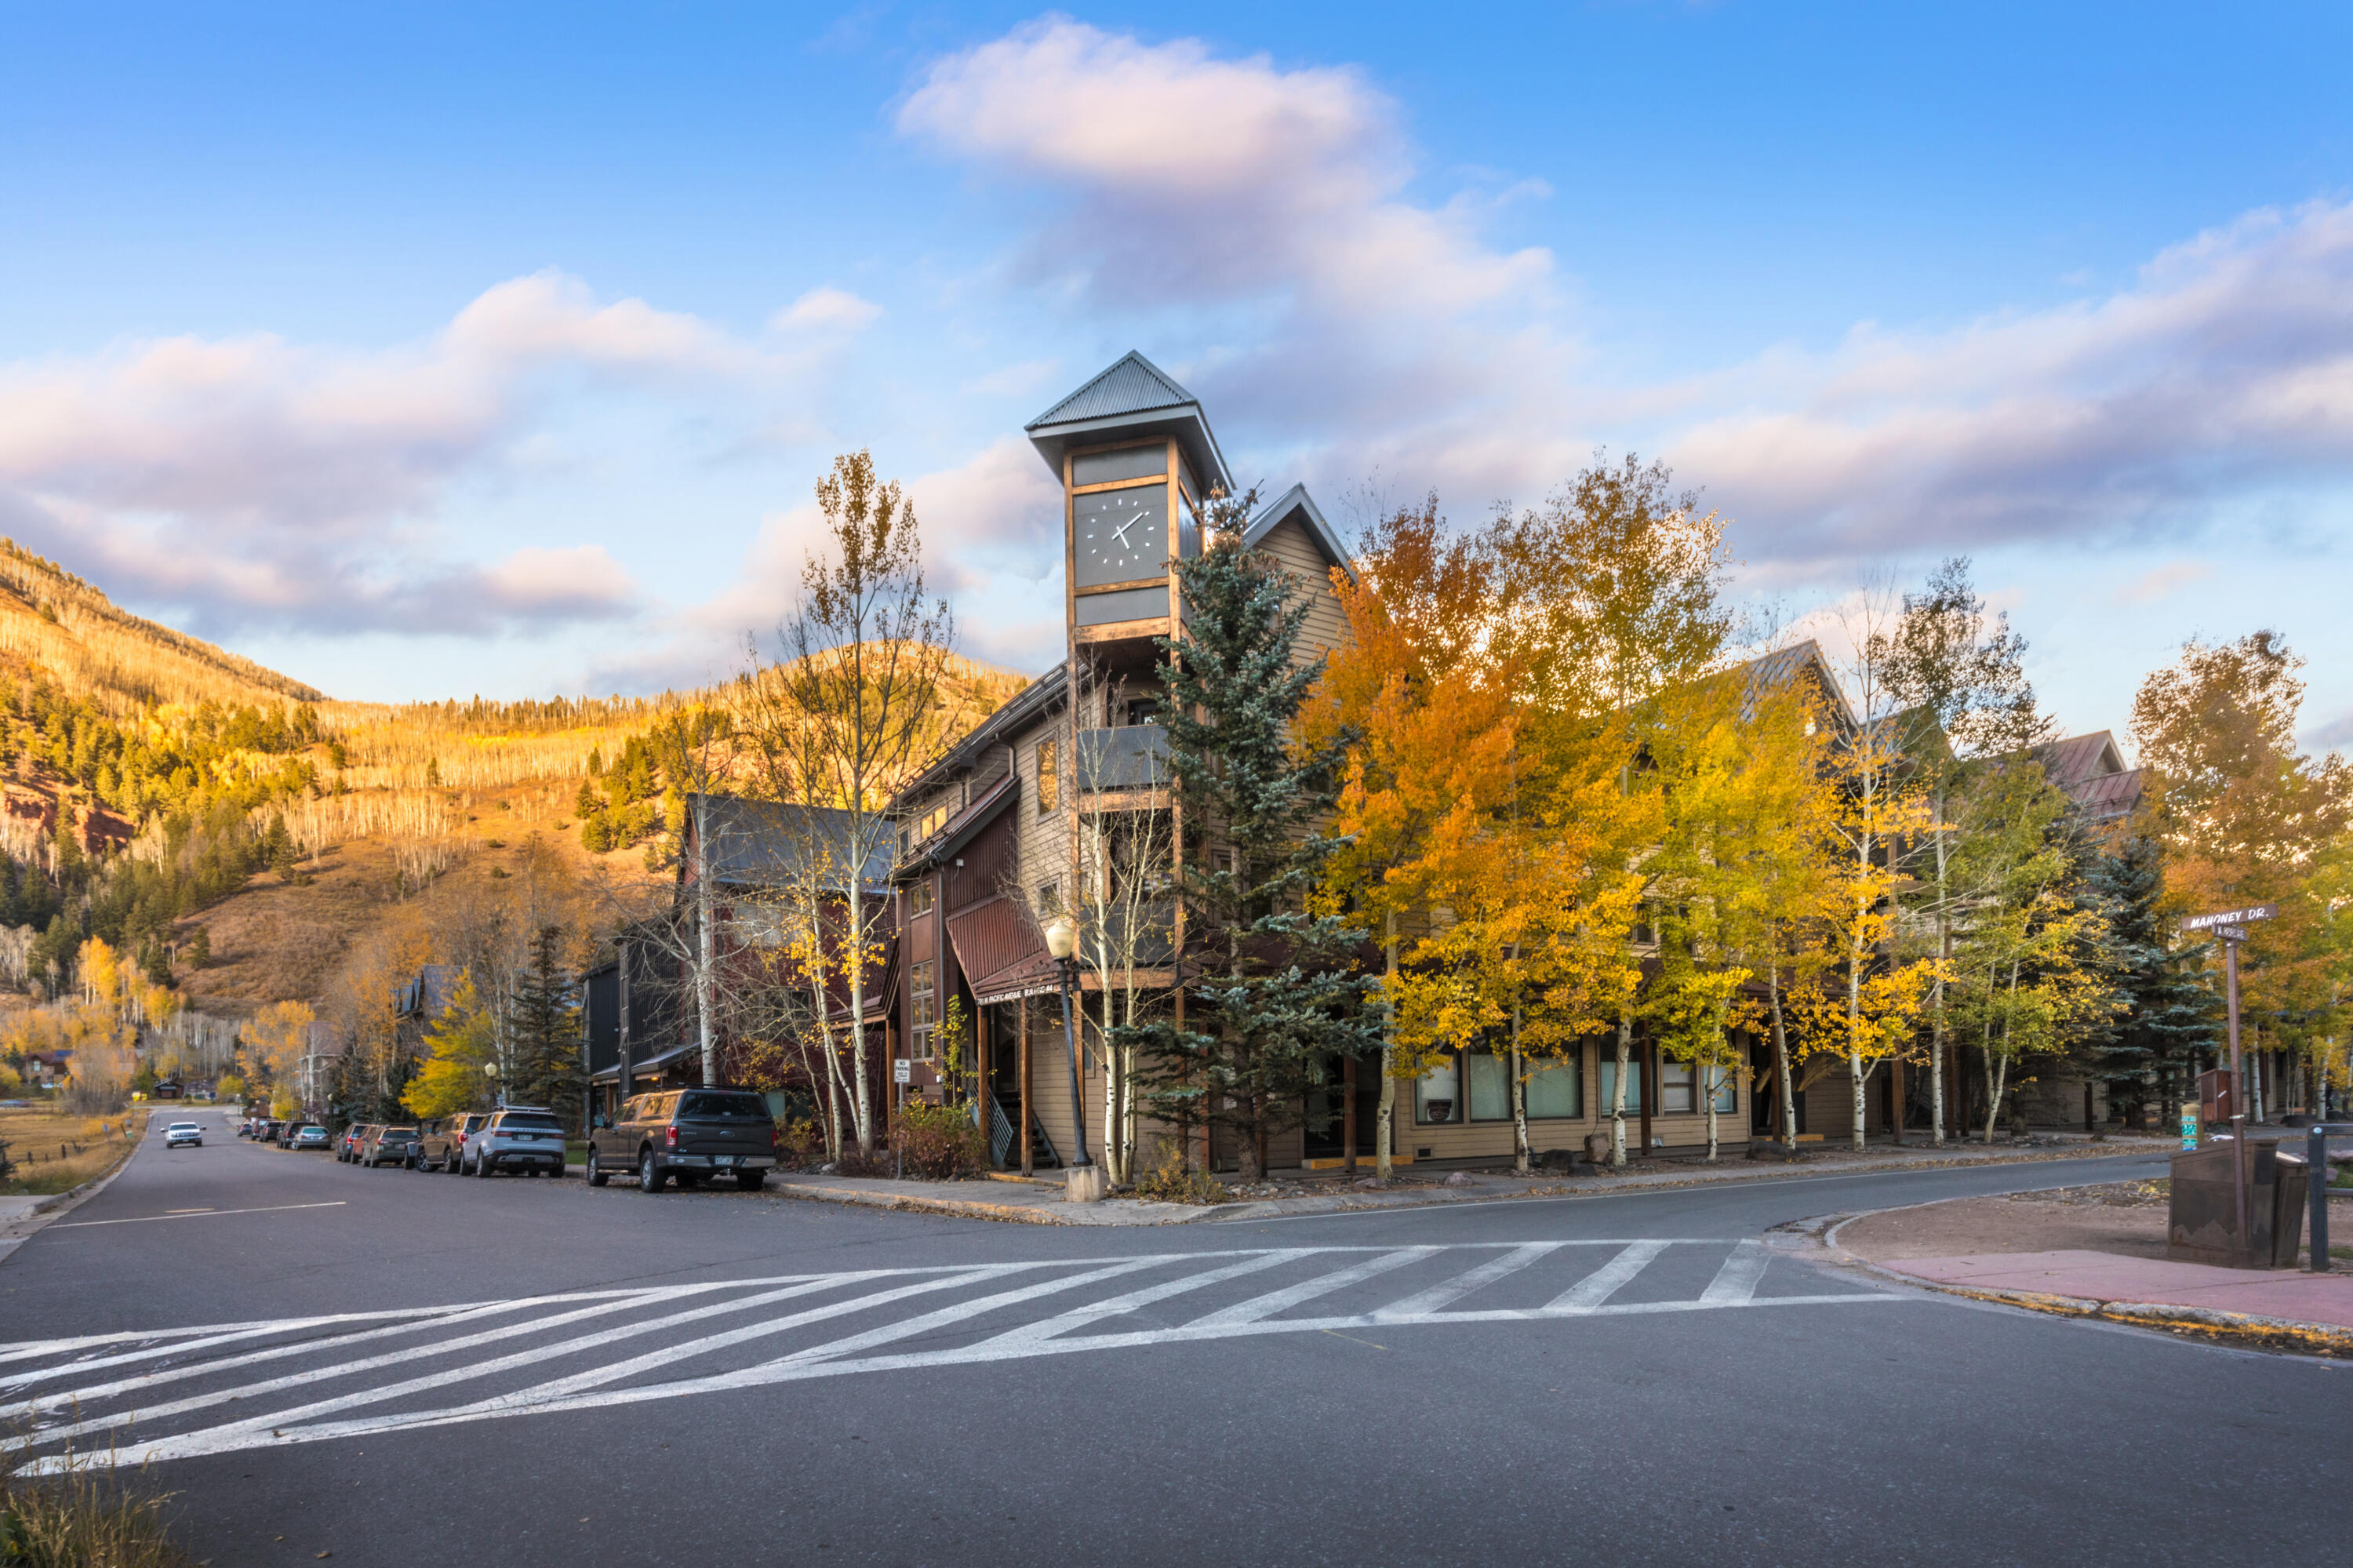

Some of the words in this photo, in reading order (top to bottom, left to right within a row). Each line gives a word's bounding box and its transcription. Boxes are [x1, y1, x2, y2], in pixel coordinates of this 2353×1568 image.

[2190, 911, 2242, 929] MAHONEY
[2247, 908, 2269, 920] DR.
[989, 994, 1004, 1002] PACIFIC
[1005, 990, 1021, 1000] AVENUE
[1024, 986, 1045, 997] BUILNG
